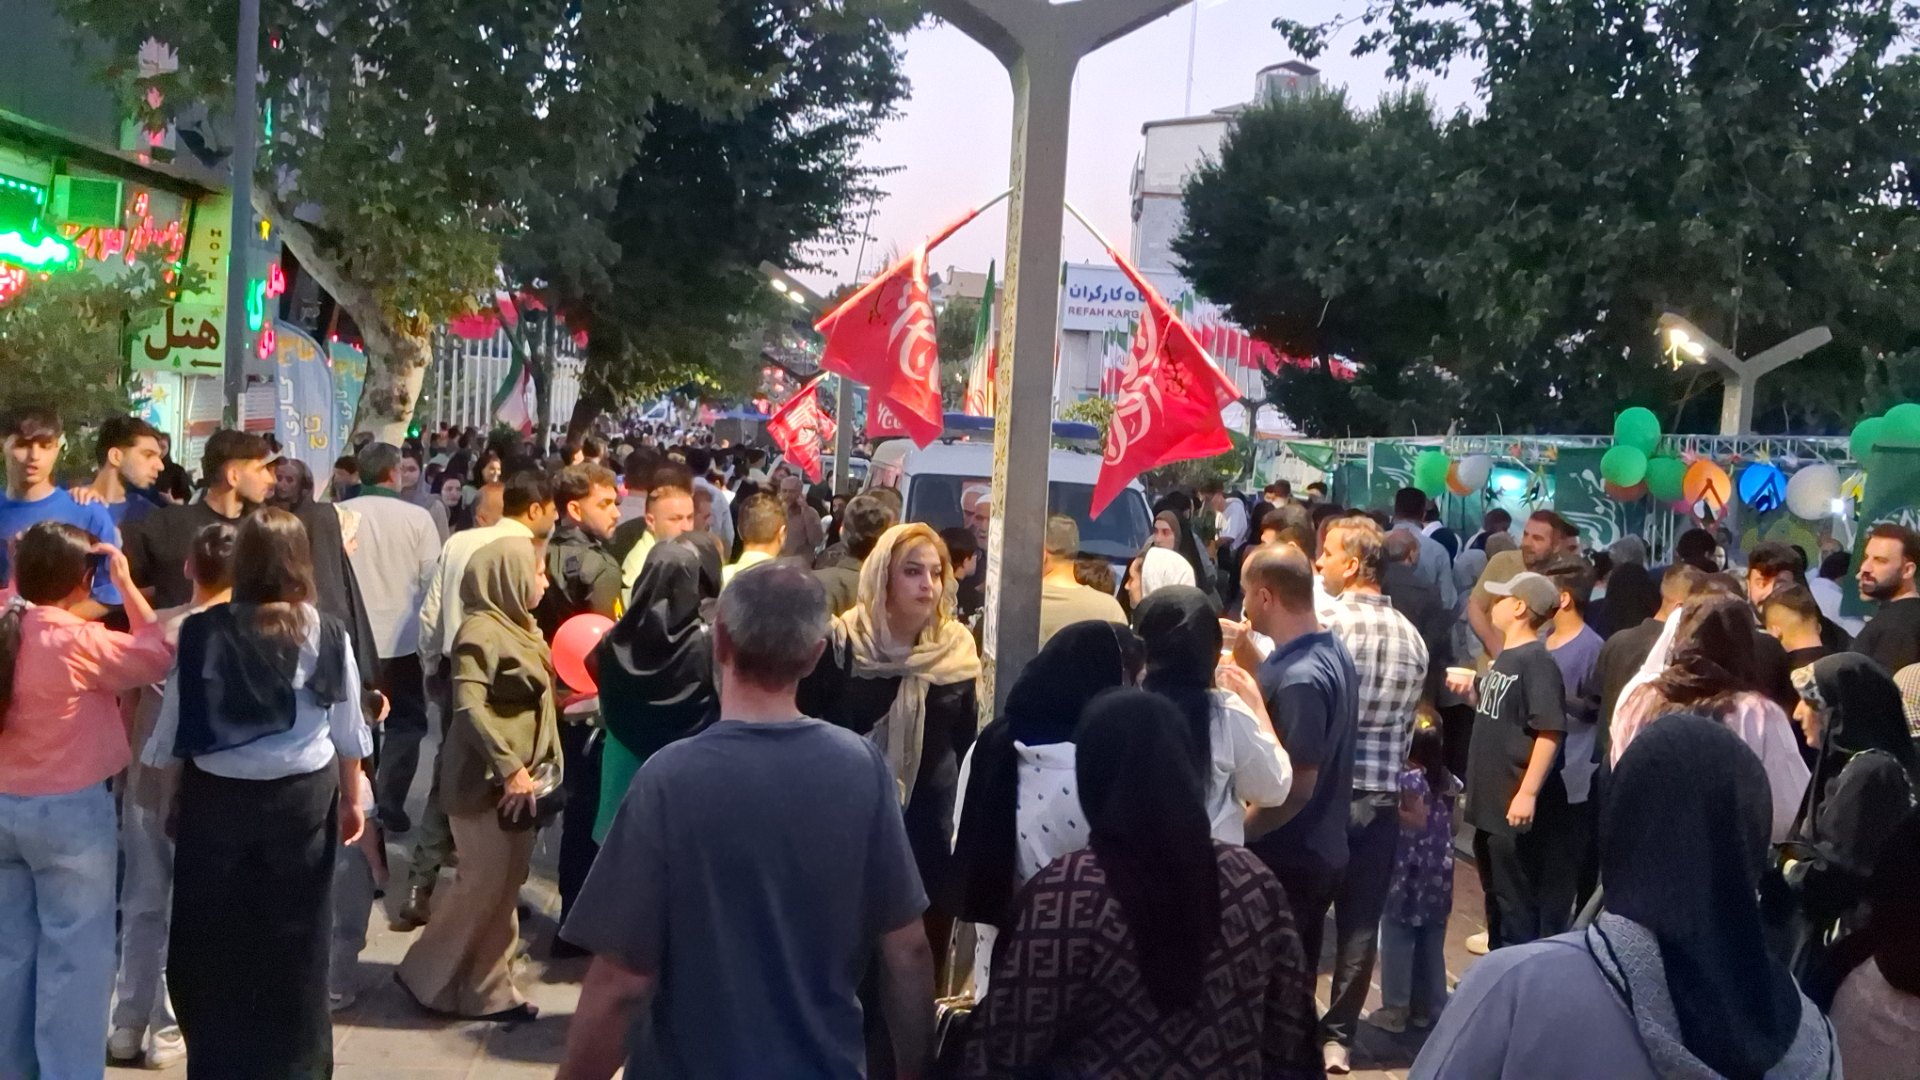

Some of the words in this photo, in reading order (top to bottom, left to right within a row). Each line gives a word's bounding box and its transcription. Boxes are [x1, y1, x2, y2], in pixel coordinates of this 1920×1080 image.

[1068, 306, 1104, 317] REFAH
[1107, 307, 1139, 319] KARG
[145, 307, 220, 360] هتل
